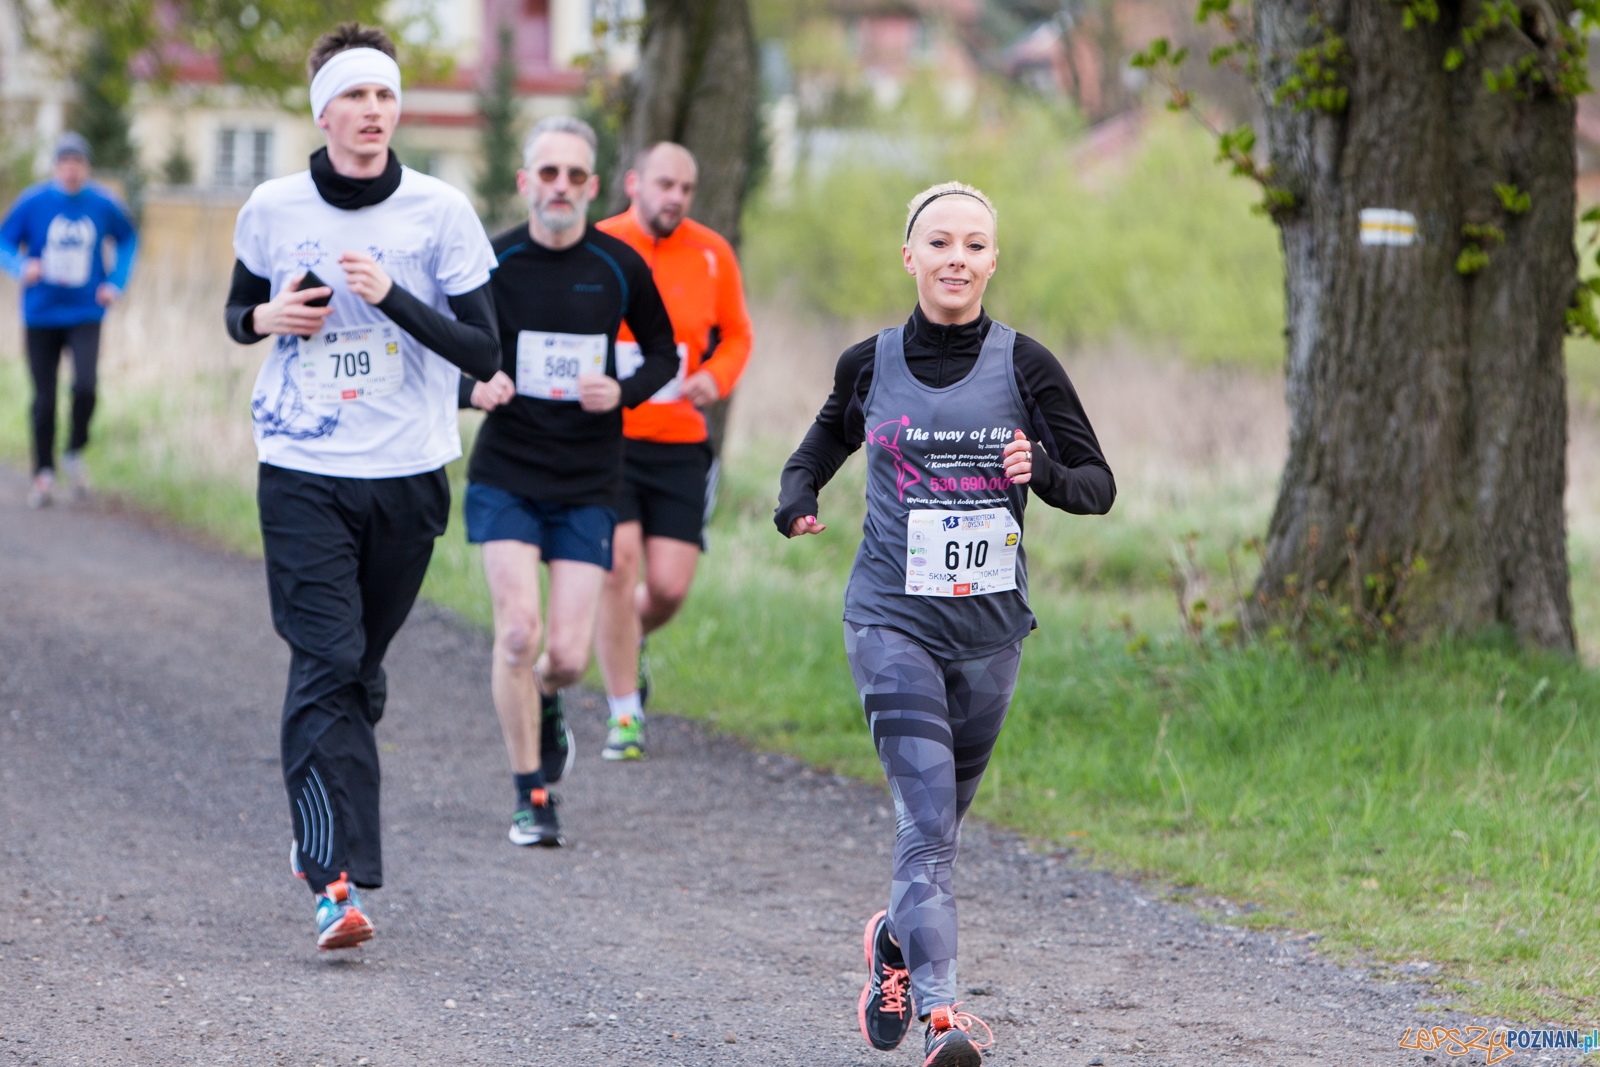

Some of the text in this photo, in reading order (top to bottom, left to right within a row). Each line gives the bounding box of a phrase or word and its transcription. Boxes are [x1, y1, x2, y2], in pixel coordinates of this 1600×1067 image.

[329, 350, 371, 378] 709
[544, 355, 580, 378] 580
[905, 427, 1012, 443] The way of life
[930, 476, 1010, 492] 530 690 010
[945, 540, 988, 570] 610
[980, 569, 999, 578] 10KM
